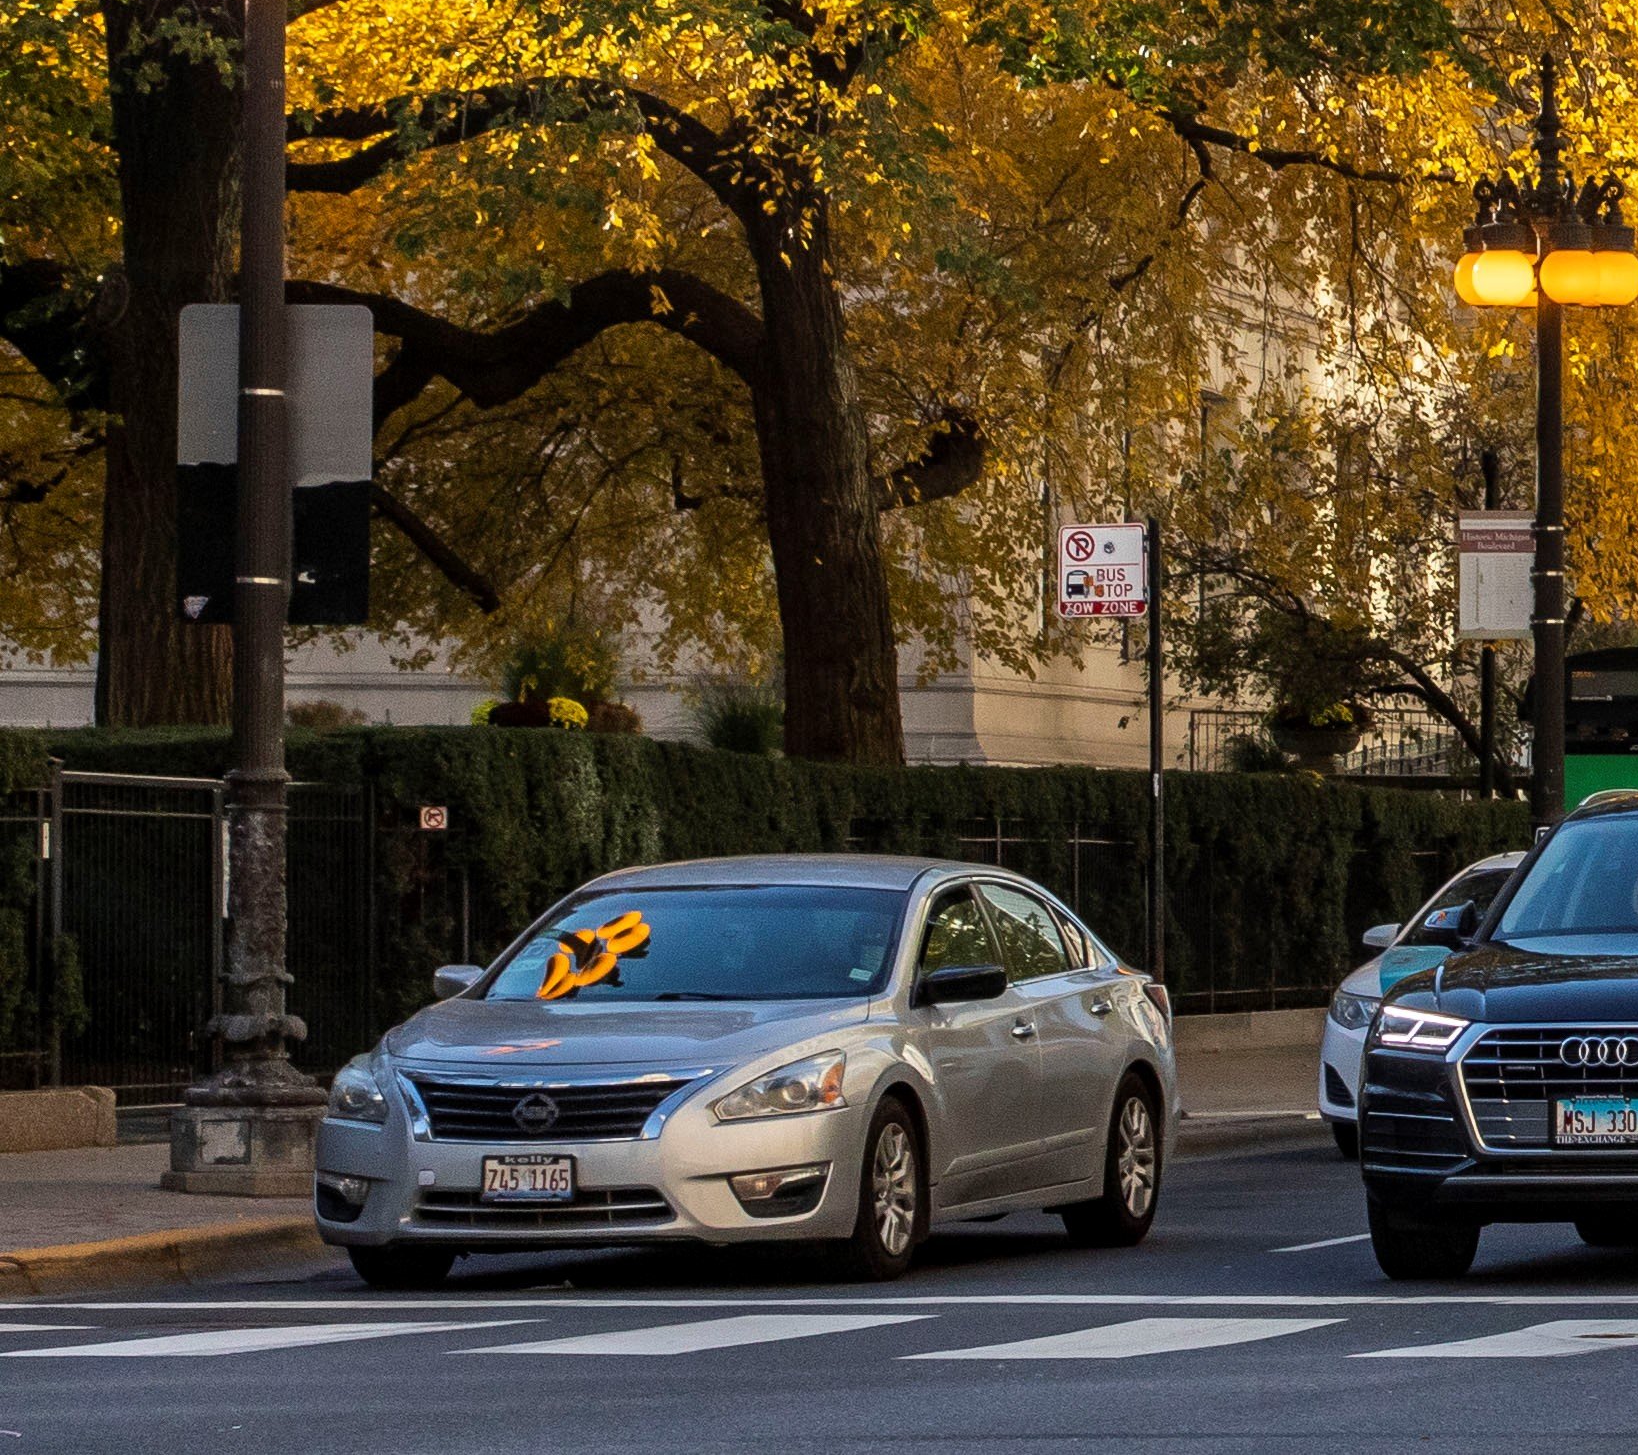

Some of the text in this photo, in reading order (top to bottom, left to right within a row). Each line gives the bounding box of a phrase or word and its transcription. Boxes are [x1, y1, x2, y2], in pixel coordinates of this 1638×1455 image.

[1096, 568, 1126, 582] BUS
[1095, 583, 1134, 598] TOP
[1065, 601, 1139, 614] TOW ZONE
[1563, 1110, 1637, 1133] MSJ 330
[487, 1169, 569, 1191] Z45 1165
